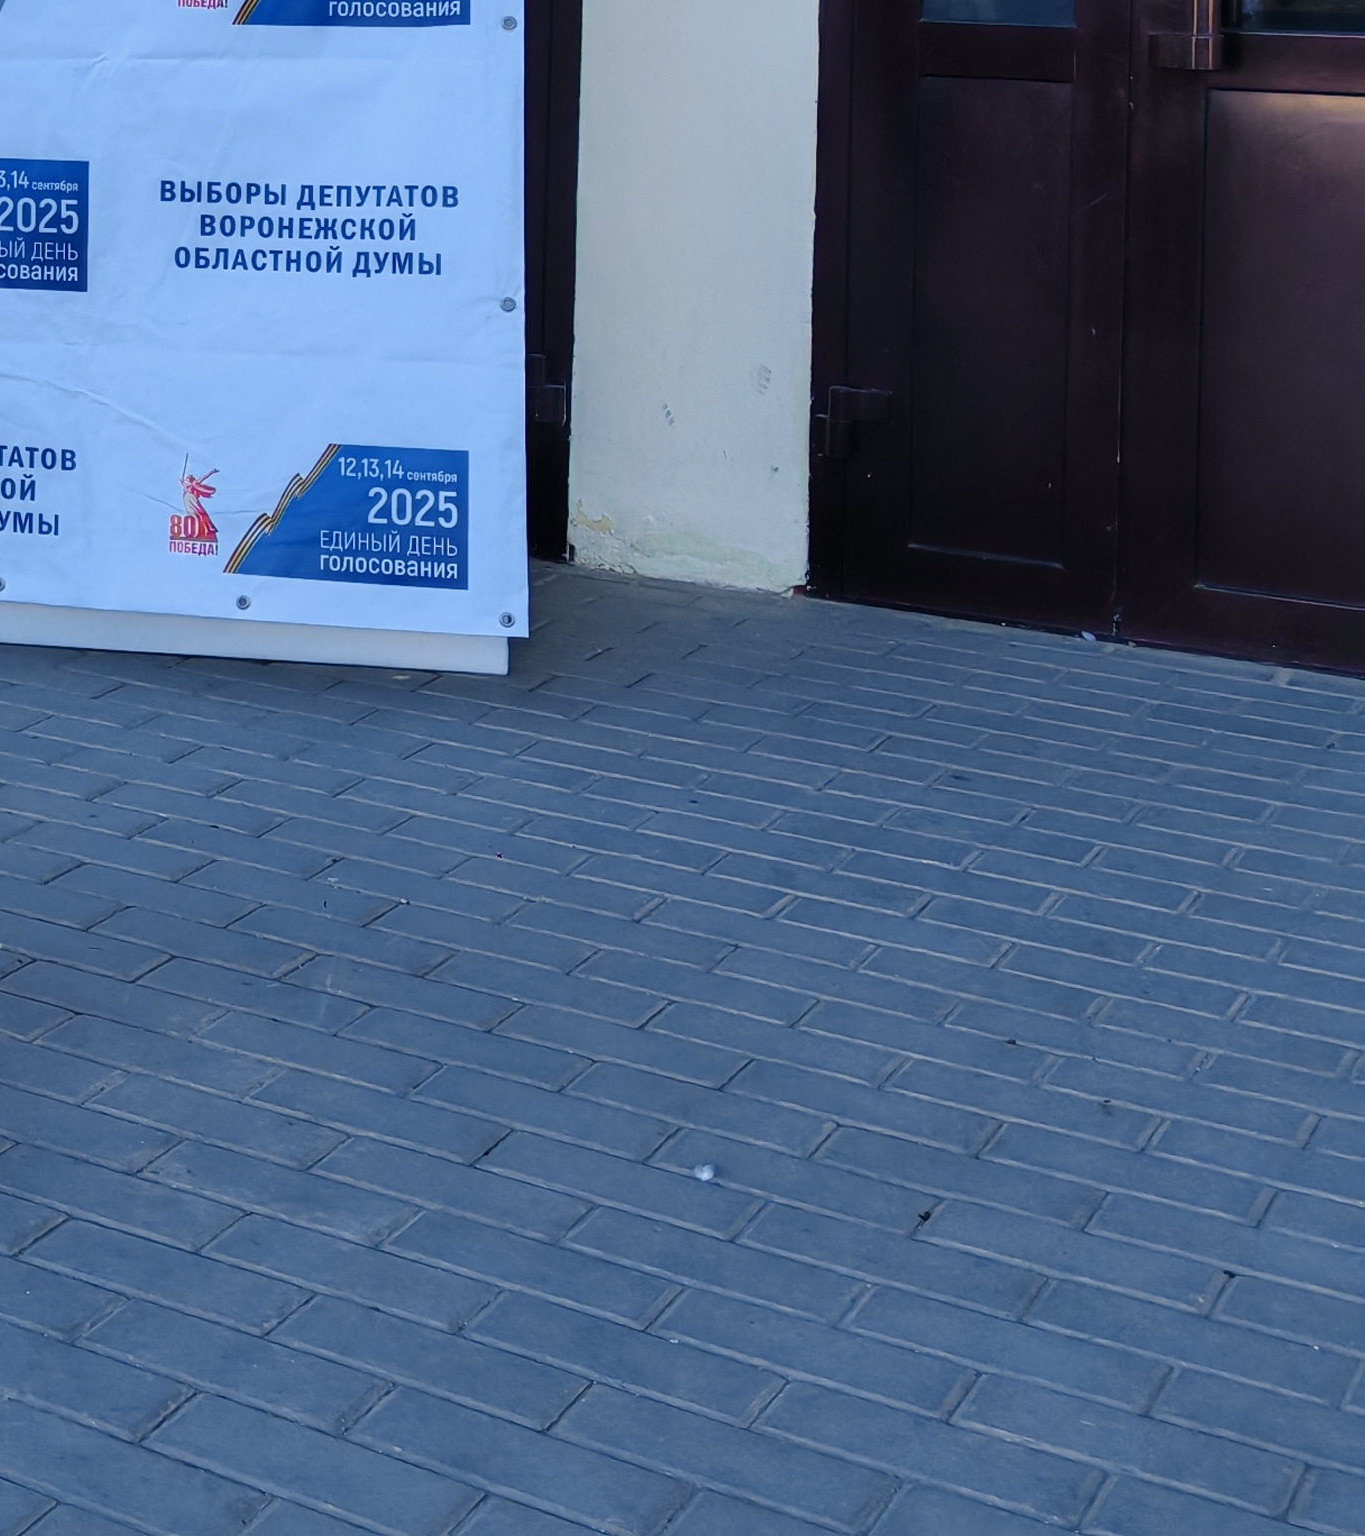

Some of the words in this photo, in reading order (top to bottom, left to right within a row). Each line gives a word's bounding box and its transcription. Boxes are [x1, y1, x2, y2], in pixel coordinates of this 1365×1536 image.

[328, 0, 462, 18] голосования
[30, 179, 79, 194] сентября
[159, 180, 287, 206] ВЫБОРЫ
[296, 183, 460, 212] ДЕПУТАТОВ
[199, 212, 417, 242] ВОРОНЕЖСКОЙ
[30, 241, 79, 263] ДЕНЬ
[173, 245, 343, 275] ОБЛАСТНОЙ
[351, 250, 443, 279] ДУМЫ
[337, 456, 405, 481] 12,13,14
[406, 470, 459, 484] сентября
[367, 485, 460, 530] 2025
[170, 513, 197, 539] 80
[168, 540, 219, 557] ПОБЕДА!
[319, 529, 401, 555] ЕДИНЫЙ
[406, 534, 459, 558] ДЕНЬ
[319, 554, 459, 580] голосования
